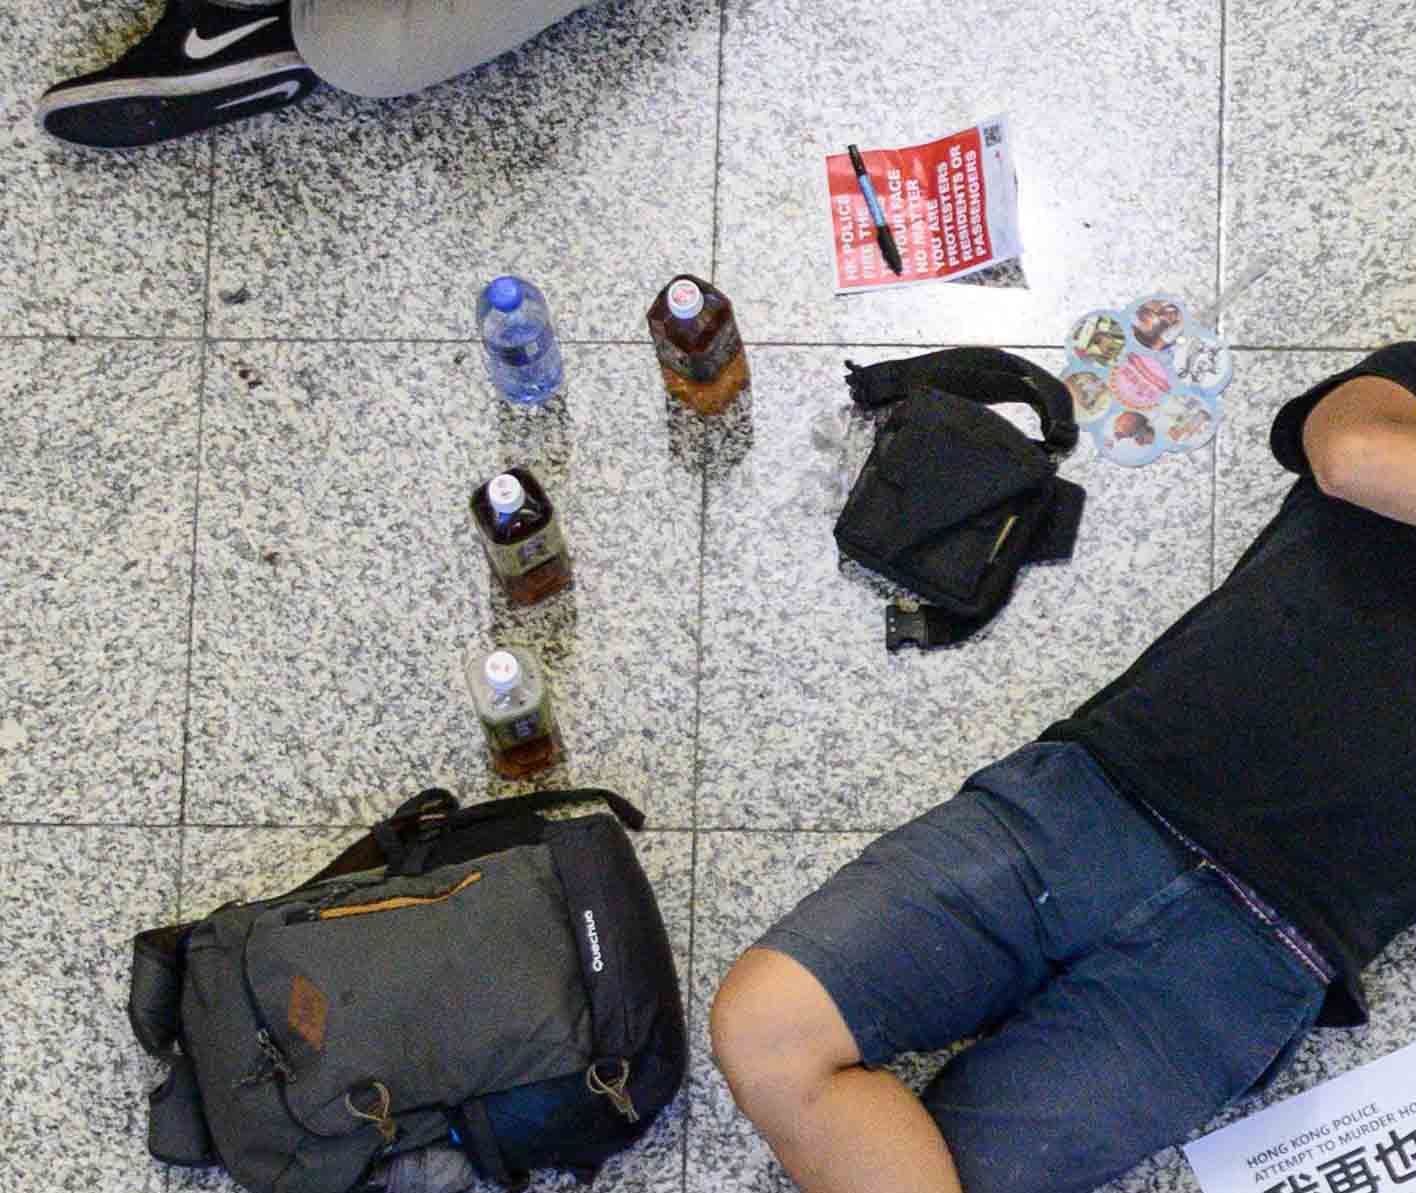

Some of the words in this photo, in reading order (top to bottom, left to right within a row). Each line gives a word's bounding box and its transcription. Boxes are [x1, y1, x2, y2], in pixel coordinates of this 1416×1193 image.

[926, 198, 941, 232] ARE
[935, 160, 960, 267] PROTESTERS
[951, 171, 974, 261] RESIDENTS
[964, 148, 987, 257] PASSENGERS
[930, 236, 946, 271] YOU
[576, 909, 605, 973] Quechua
[1246, 1139, 1290, 1170] HONG
[1289, 1121, 1331, 1152] KONG
[1331, 1102, 1379, 1133] POLICE
[1253, 1152, 1316, 1184] ATTEMPT
[1316, 1139, 1337, 1156] TO
[1337, 1111, 1397, 1146] MURDER
